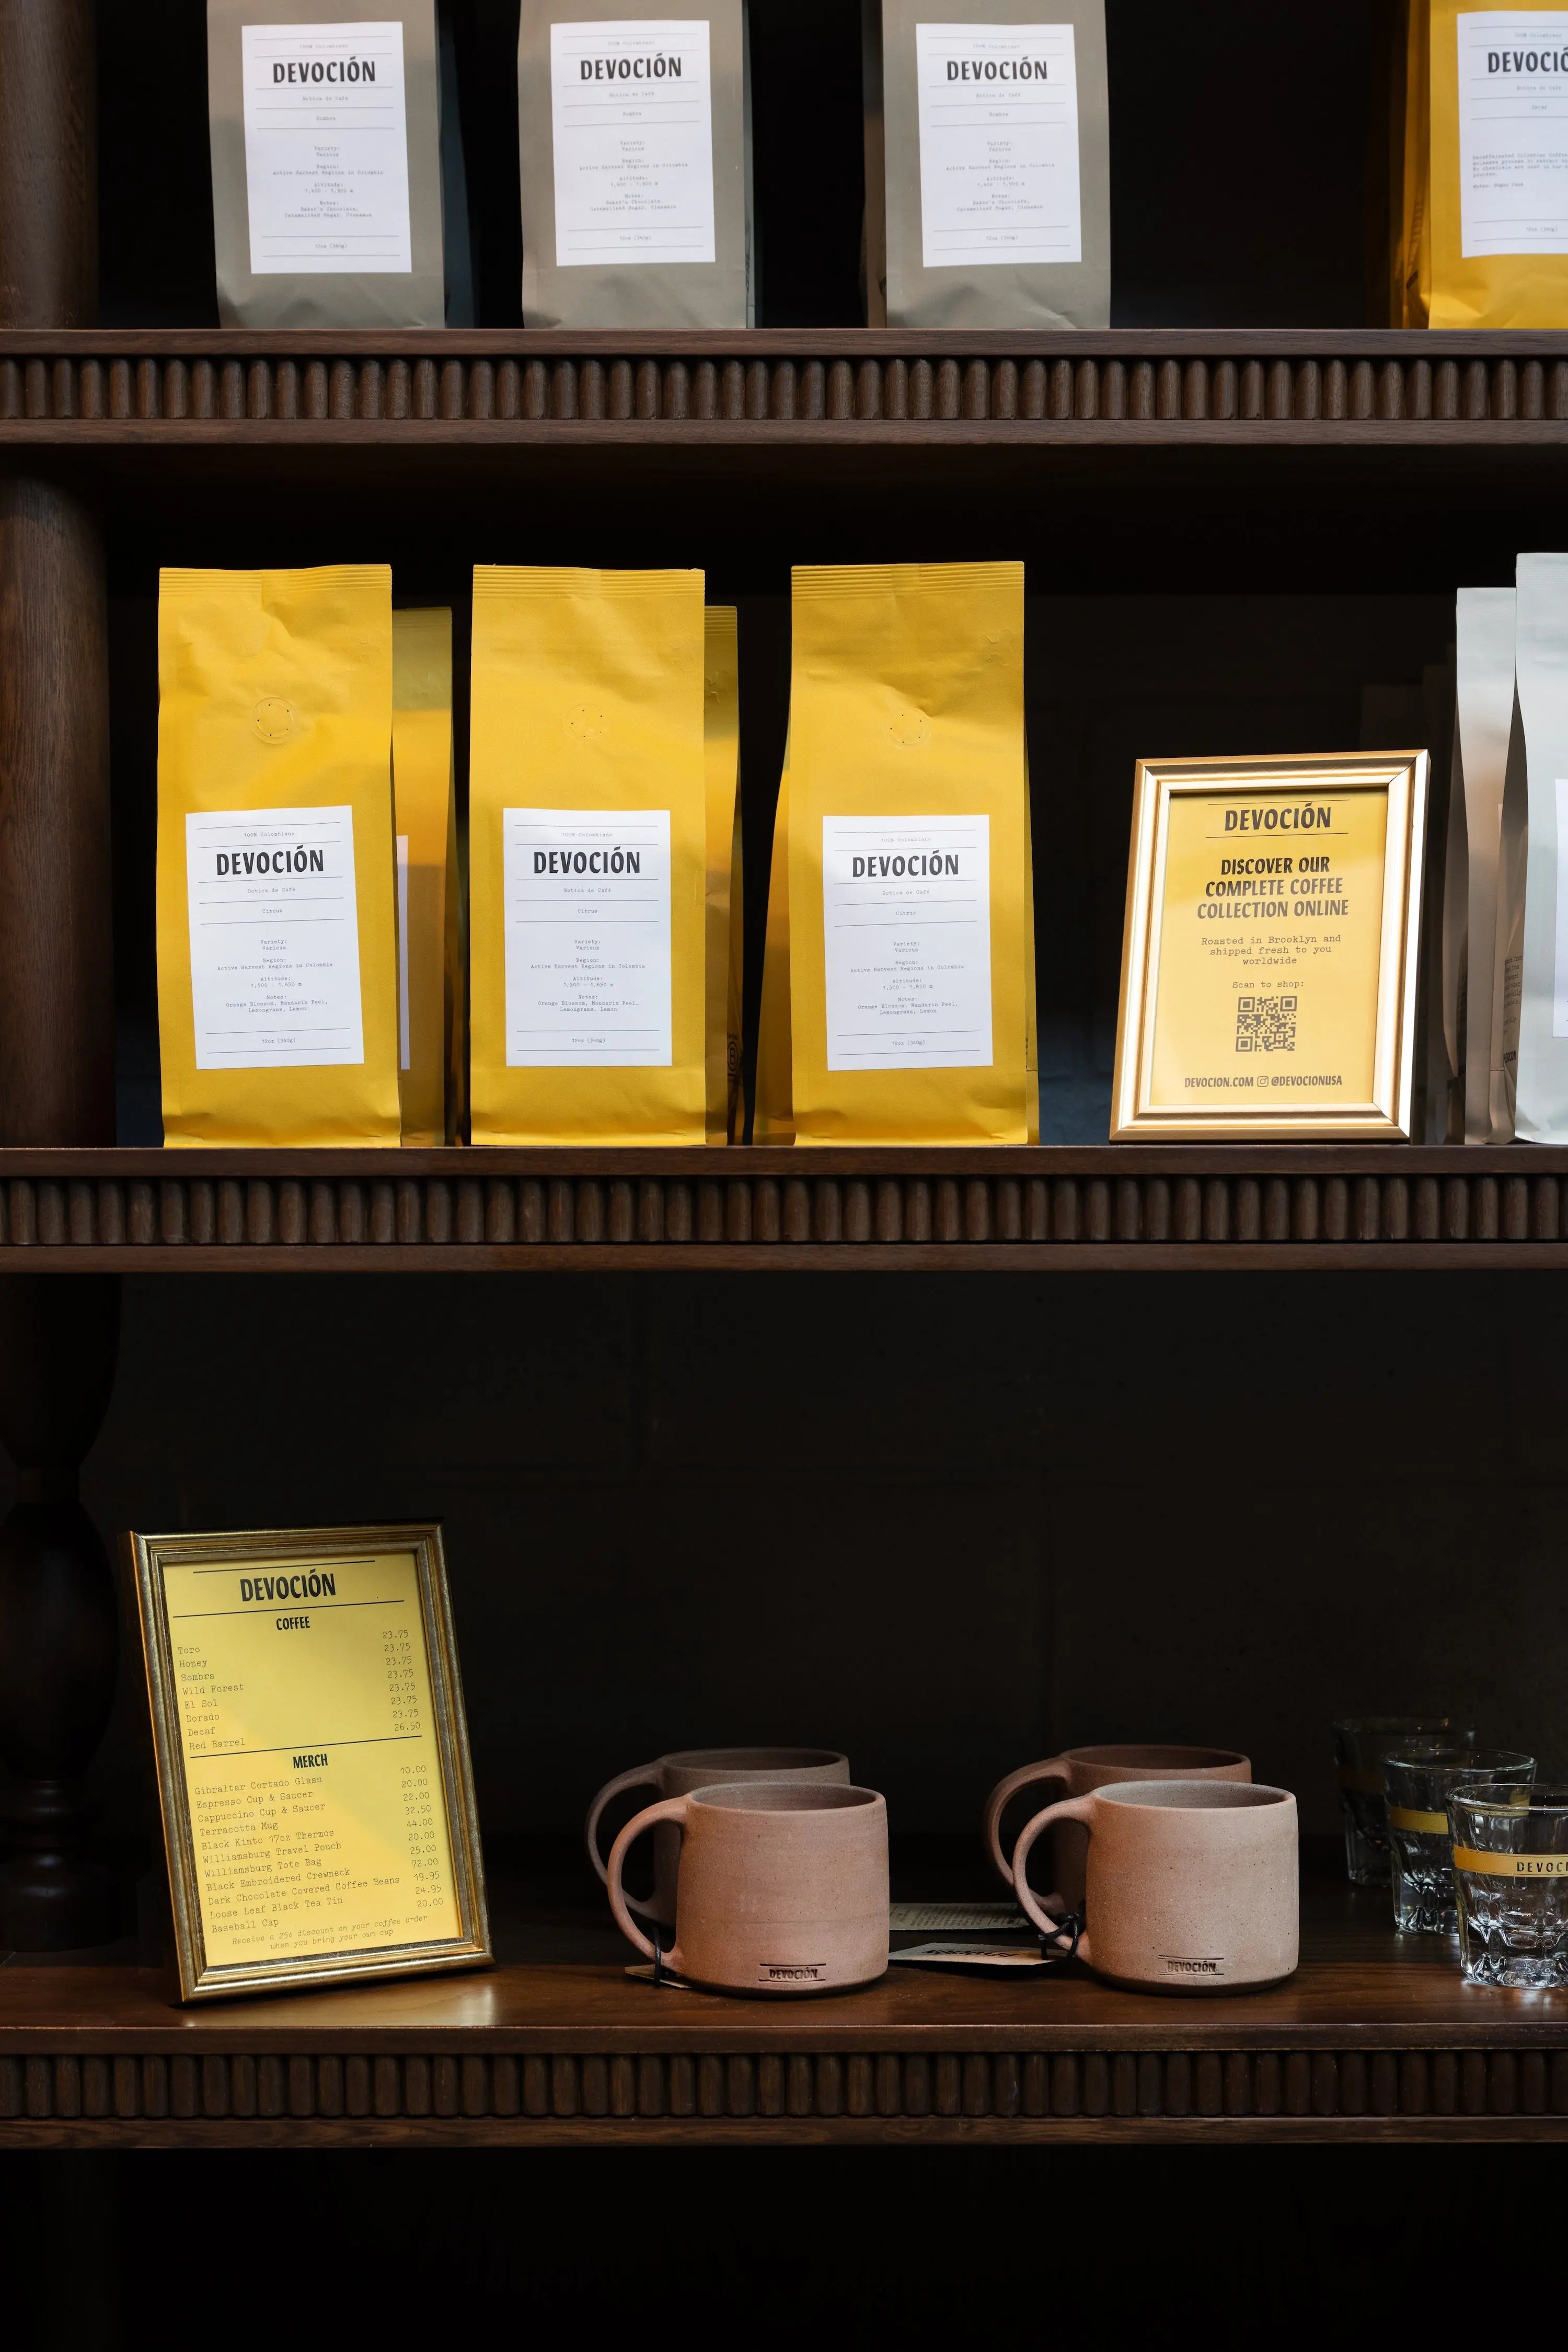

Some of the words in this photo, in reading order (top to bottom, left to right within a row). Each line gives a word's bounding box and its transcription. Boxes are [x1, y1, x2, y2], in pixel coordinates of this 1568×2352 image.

[1488, 47, 1568, 73] DEVOCIÓ
[273, 56, 375, 83] DEVOCIÓN
[581, 53, 682, 80] DEVOCIÓN
[947, 56, 1047, 80] DEVOCIÓN
[1225, 803, 1331, 831] DEVOCIÓN
[216, 845, 324, 876] DEVOCIÓN
[534, 846, 640, 874] DEVOCIÓN
[852, 850, 959, 878] DEVOCIÓN
[1221, 857, 1293, 875] DISCOVER
[1298, 856, 1330, 873] OUR
[1206, 879, 1285, 897] COMPLETE
[1290, 878, 1343, 895] COFFEE
[1197, 901, 1288, 919] COLLECTION
[1294, 899, 1349, 917] ONLINE
[1201, 937, 1244, 946] Roasted
[1267, 935, 1317, 944] Brooklyn
[1323, 934, 1341, 942] and
[1210, 947, 1252, 957] shipped
[1258, 946, 1289, 954] fresh
[1242, 956, 1297, 965] worldwide
[1277, 980, 1304, 989] shop:
[1184, 1076, 1254, 1088] DEVOCION.COM
[1271, 1075, 1342, 1087] @DEVOCIONUSA
[240, 1568, 336, 1602] DEVOCIÓN
[276, 1616, 310, 1631] COFFEE
[382, 1630, 409, 1640] 23.75
[177, 1646, 201, 1655] Toro
[384, 1642, 410, 1653] 23.75
[386, 1655, 412, 1666] 23.75
[181, 1673, 215, 1681] Sombra
[387, 1669, 414, 1679] 23.75
[182, 1686, 205, 1696] Wild
[210, 1684, 244, 1693] Forest
[389, 1682, 416, 1692] 23.75
[184, 1701, 196, 1709] El
[201, 1699, 218, 1708] Sol
[391, 1695, 417, 1705] 23.75
[186, 1713, 220, 1723] Dorado
[393, 1709, 419, 1719] 23.75
[187, 1726, 215, 1736] Decaf
[394, 1722, 420, 1731] 26.50
[189, 1741, 206, 1750] Red
[211, 1737, 246, 1748] Barrel
[293, 1753, 328, 1769] MERCH
[400, 1765, 426, 1774] 10.00
[194, 1784, 246, 1795] Gibraltar
[250, 1779, 290, 1790] Cortado
[295, 1777, 322, 1785] Glass
[401, 1778, 428, 1788] 20.00
[196, 1798, 241, 1809] Espresso
[247, 1796, 263, 1805] Cup
[269, 1793, 275, 1802] &
[280, 1791, 313, 1800] Saucer
[403, 1791, 430, 1802] 22.00
[198, 1811, 254, 1824] Cappuccino
[259, 1808, 276, 1817] Cup
[282, 1806, 288, 1814] &
[293, 1804, 326, 1813] Saucer
[405, 1804, 431, 1816] 32.50
[407, 1818, 433, 1827] 44.00
[200, 1824, 256, 1837] Terracotta
[261, 1821, 279, 1830] Mug
[201, 1840, 229, 1850] Black
[235, 1837, 263, 1847] Kinto
[269, 1834, 291, 1843] 17oz
[296, 1830, 334, 1840] Thermos
[408, 1831, 435, 1841] 20.00
[202, 1851, 271, 1864] Williamsburg
[275, 1845, 309, 1855] Travel
[314, 1841, 342, 1852] Pouch
[410, 1844, 436, 1855] 25.00
[204, 1864, 272, 1877] Williamsburg
[277, 1861, 299, 1870] Tote
[305, 1858, 322, 1867] Bag
[411, 1858, 438, 1869] 72.00
[1517, 1862, 1568, 1872] DEVOCI
[206, 1881, 235, 1892] Black
[240, 1873, 302, 1888] Embroidered
[306, 1868, 351, 1880] Crewneck
[413, 1871, 440, 1882] 19.95
[207, 1896, 231, 1905] Dark
[236, 1890, 286, 1902] Chocolate
[292, 1884, 330, 1895] Covered
[335, 1881, 368, 1890] Coffee
[373, 1877, 400, 1886] Beans
[415, 1884, 442, 1895] 24.95
[209, 1910, 238, 1919] Loose
[243, 1905, 266, 1915] Leaf
[271, 1901, 299, 1912] Black
[304, 1899, 321, 1908] Tea
[326, 1897, 343, 1906] Tin
[417, 1897, 443, 1908] 20.00
[211, 1920, 256, 1933] Baseball
[262, 1919, 279, 1928] Cap
[232, 1935, 264, 1945] Receive
[279, 1931, 292, 1940] 25¢
[297, 1926, 334, 1937] discount
[351, 1923, 370, 1932] your
[374, 1919, 401, 1928] coffee
[405, 1915, 428, 1923] order
[293, 1940, 308, 1949] you
[312, 1936, 335, 1944] bring
[339, 1934, 358, 1943] your
[769, 1967, 817, 1979] DEVOCIÓN
[1167, 1961, 1216, 1973] DEVOCIÓN
